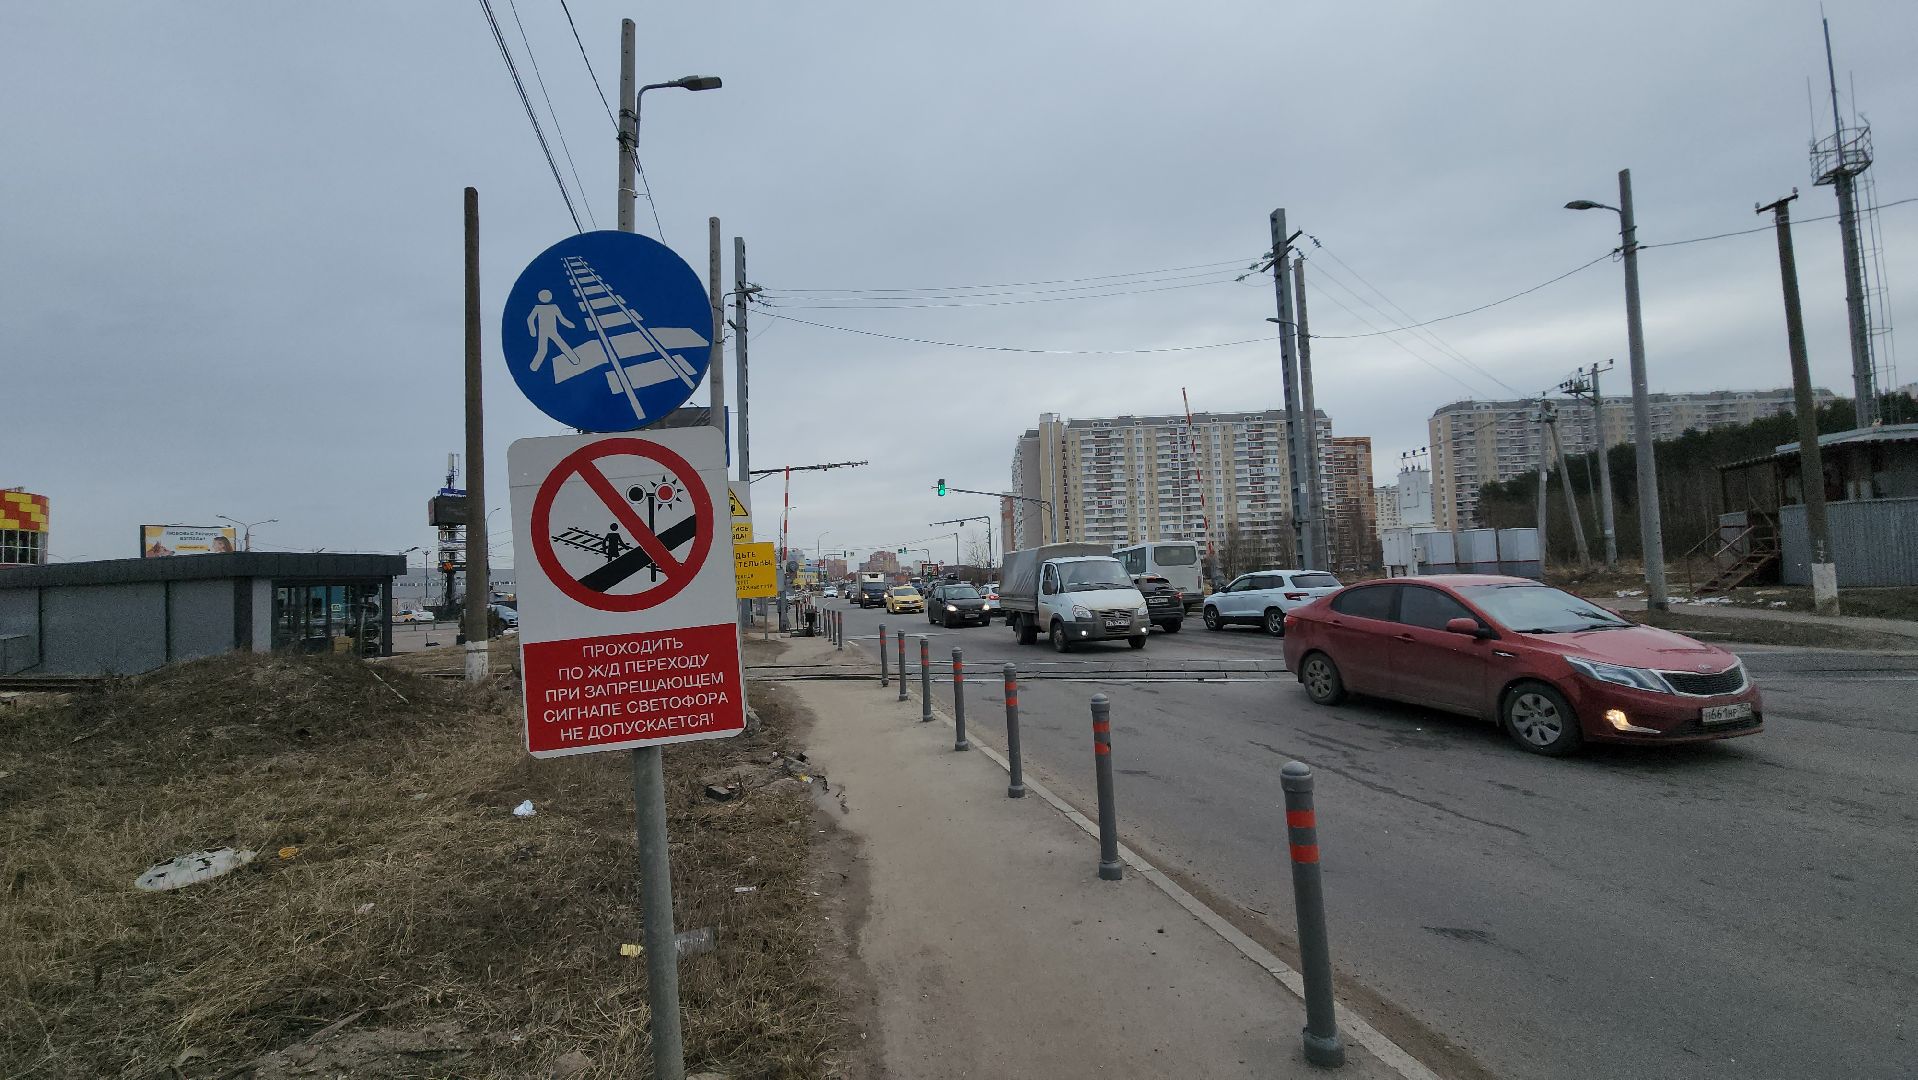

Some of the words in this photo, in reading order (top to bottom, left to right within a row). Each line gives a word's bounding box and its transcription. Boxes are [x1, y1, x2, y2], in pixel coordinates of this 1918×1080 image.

[582, 637, 684, 658] ПРОХОДИТЬ
[558, 666, 584, 681] ПО
[587, 662, 621, 679] Ж/Д
[624, 653, 710, 674] ПЕРЕХОДУ
[545, 686, 580, 703] ПРИ
[584, 671, 724, 699] ЗАПРЕЩАЮЩЕМ
[543, 702, 623, 723] СИГНАЛЕ
[626, 691, 729, 714] СВЕТОФОРА
[560, 726, 584, 742] НЕ
[587, 712, 715, 741] ДОПУСКАЕТСЯ!
